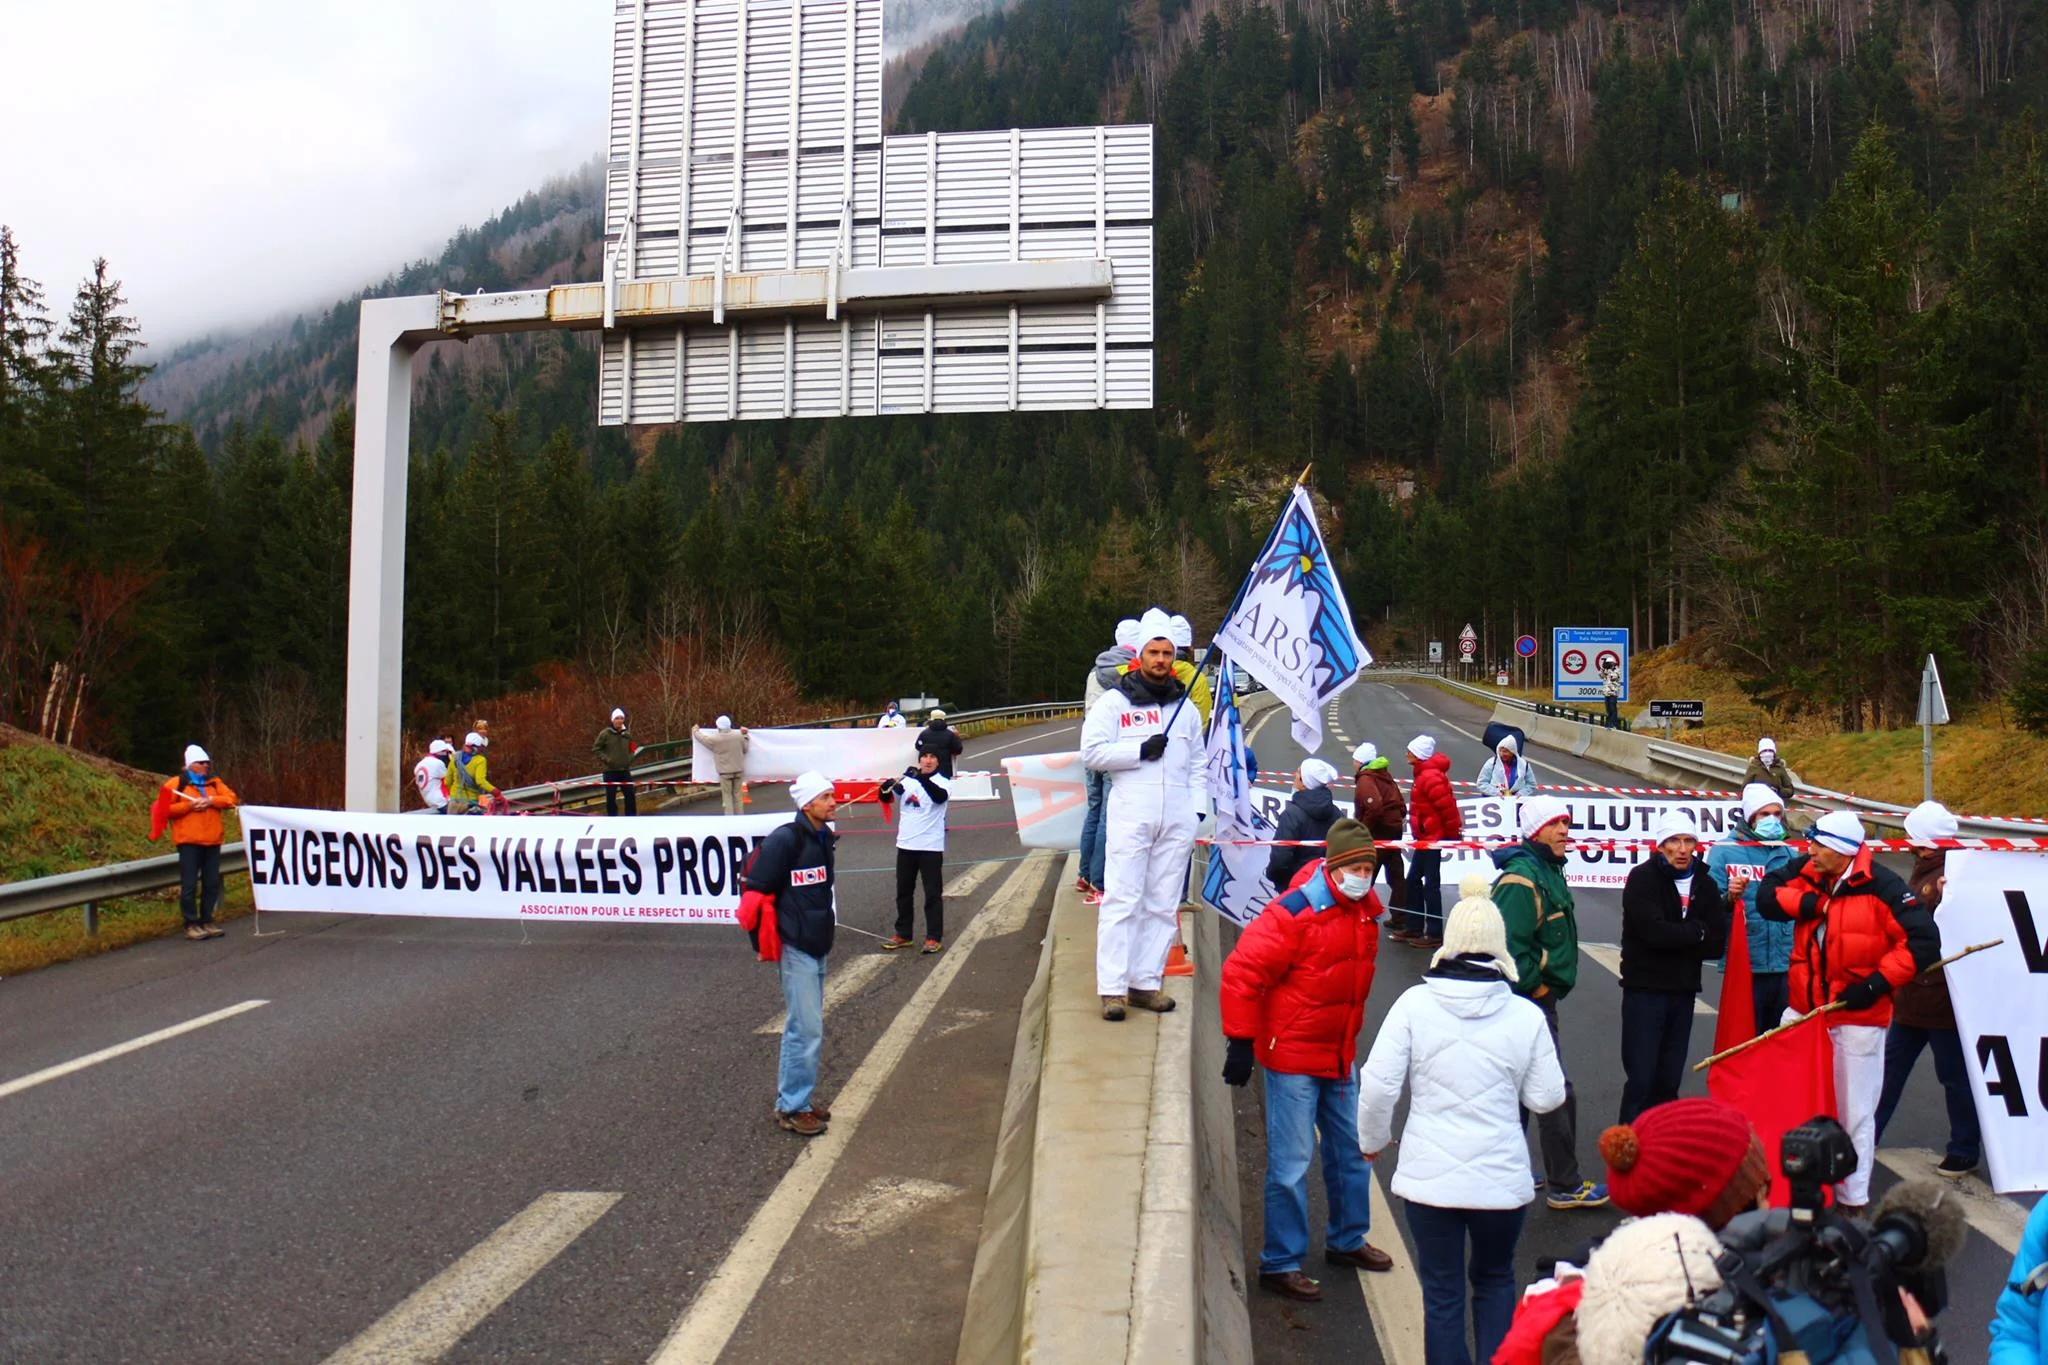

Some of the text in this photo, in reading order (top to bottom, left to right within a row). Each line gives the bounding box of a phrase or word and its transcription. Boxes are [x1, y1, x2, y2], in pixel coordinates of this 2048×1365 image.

[1121, 710, 1160, 728] NON
[250, 829, 408, 890] EXIGEONS
[416, 834, 481, 892] DES
[490, 824, 643, 895] VALLÉES
[793, 867, 825, 885] NON
[1727, 865, 1764, 879] NON
[520, 904, 588, 915] ASSOCIATION
[591, 906, 620, 916] POUR
[623, 907, 636, 916] LE
[639, 907, 686, 918] RESPECT
[689, 908, 704, 918] DU
[707, 909, 731, 918] SITE
